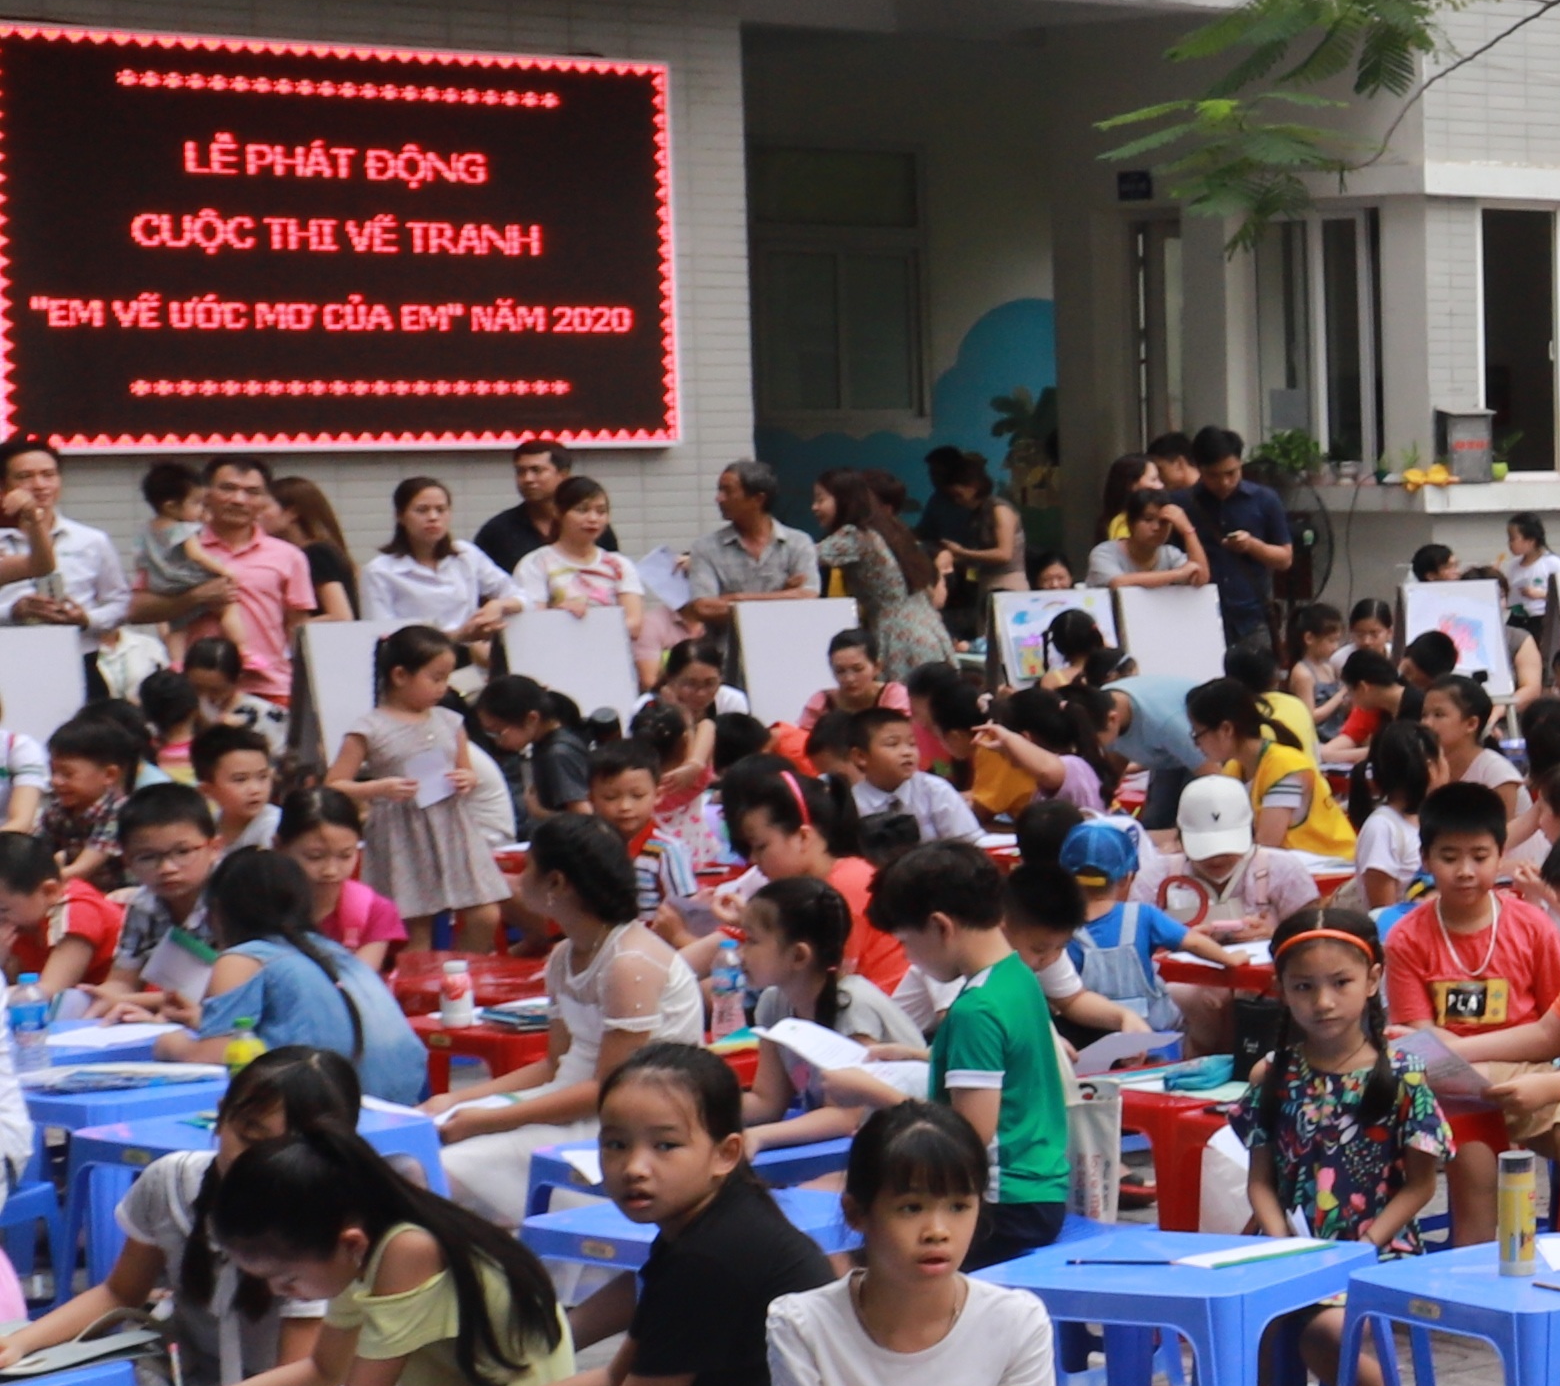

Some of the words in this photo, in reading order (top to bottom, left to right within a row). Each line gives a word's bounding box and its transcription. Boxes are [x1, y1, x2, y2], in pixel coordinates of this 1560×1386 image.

[184, 132, 239, 175] LỄ
[246, 139, 355, 180] PHÁT
[365, 143, 488, 190] ĐỘNG
[130, 208, 255, 255] CUỘC
[263, 217, 340, 252] THI
[345, 215, 398, 254] VẼ
[406, 221, 542, 256] TRANH
[29, 295, 102, 327] "EM
[112, 294, 163, 328] VẼ
[170, 294, 248, 330] ƯỚC
[255, 302, 314, 331] MƠ
[321, 293, 394, 333] CỦA
[400, 303, 464, 333] EM"
[470, 298, 545, 334] NĂM
[552, 305, 634, 335] 2020
[1447, 993, 1484, 1012] PLA
